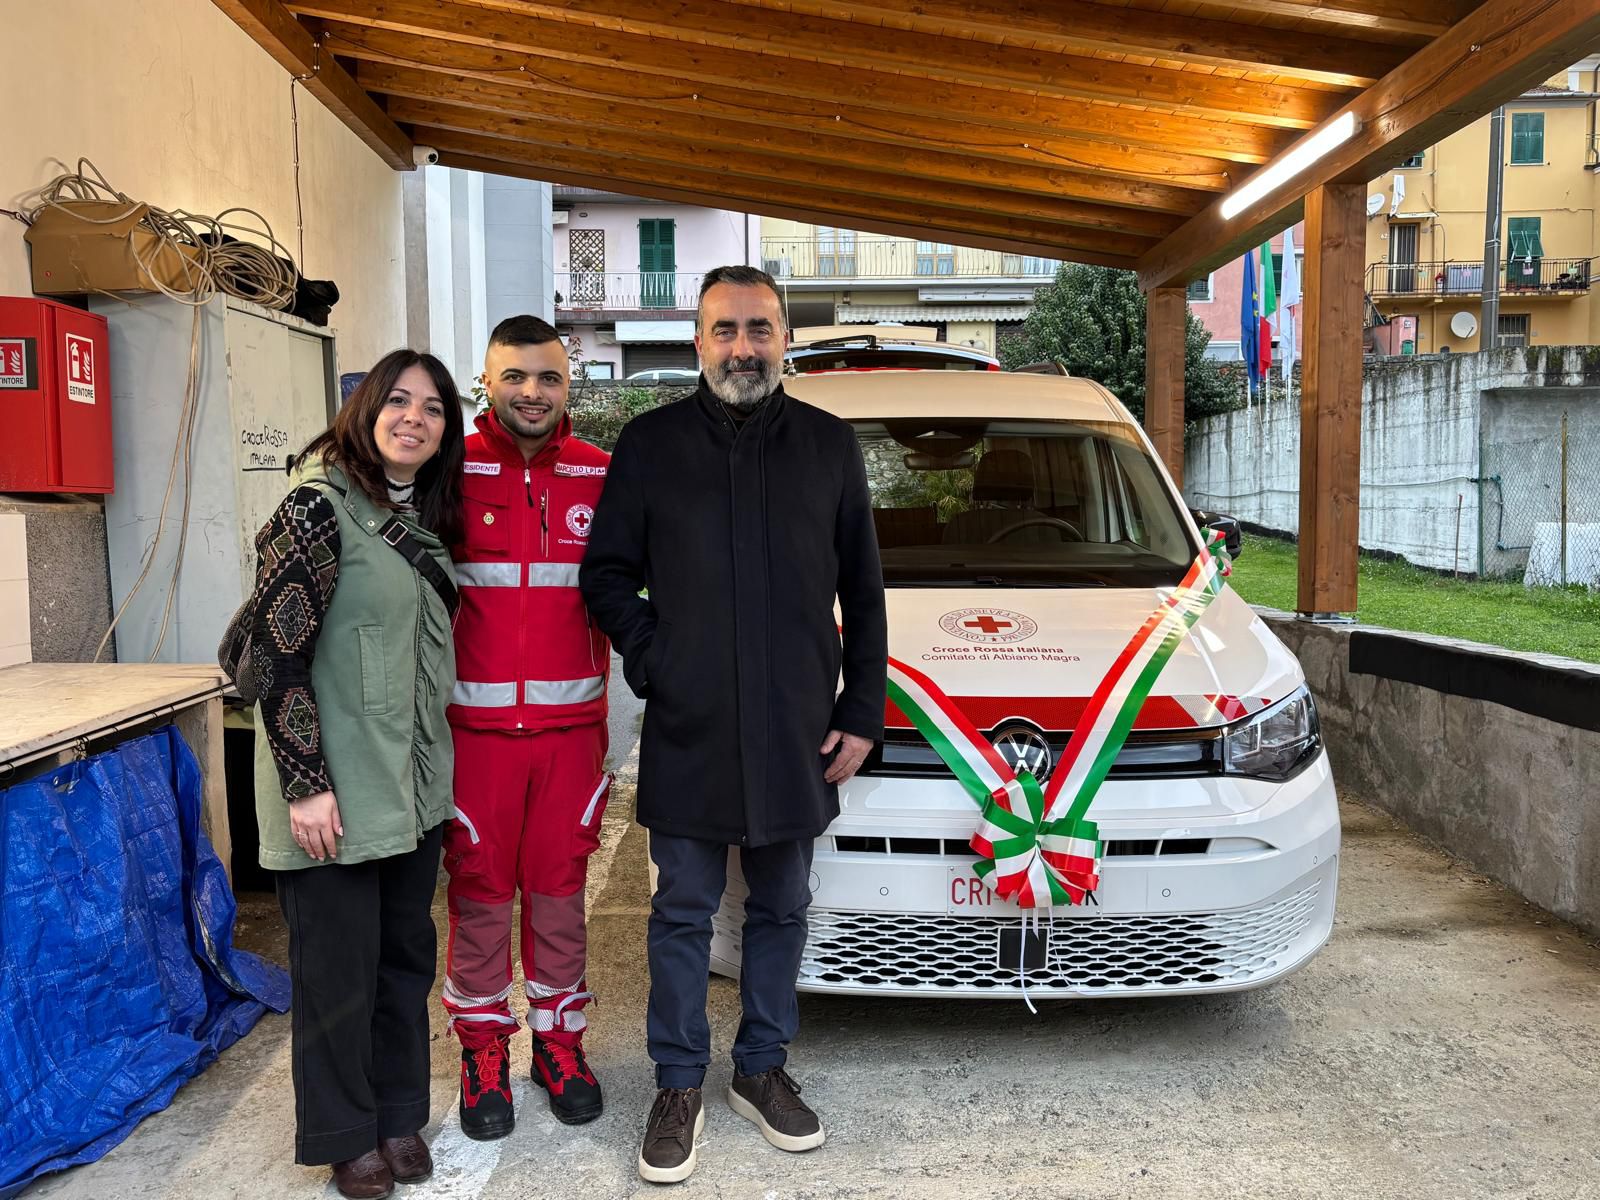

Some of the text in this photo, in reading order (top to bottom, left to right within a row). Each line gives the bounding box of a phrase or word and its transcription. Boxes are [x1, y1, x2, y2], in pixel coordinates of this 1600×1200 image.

[69, 385, 94, 399] ESTINTORE
[556, 464, 584, 474] MARCELLO
[921, 653, 1081, 663] Comitato di Albiano Magra
